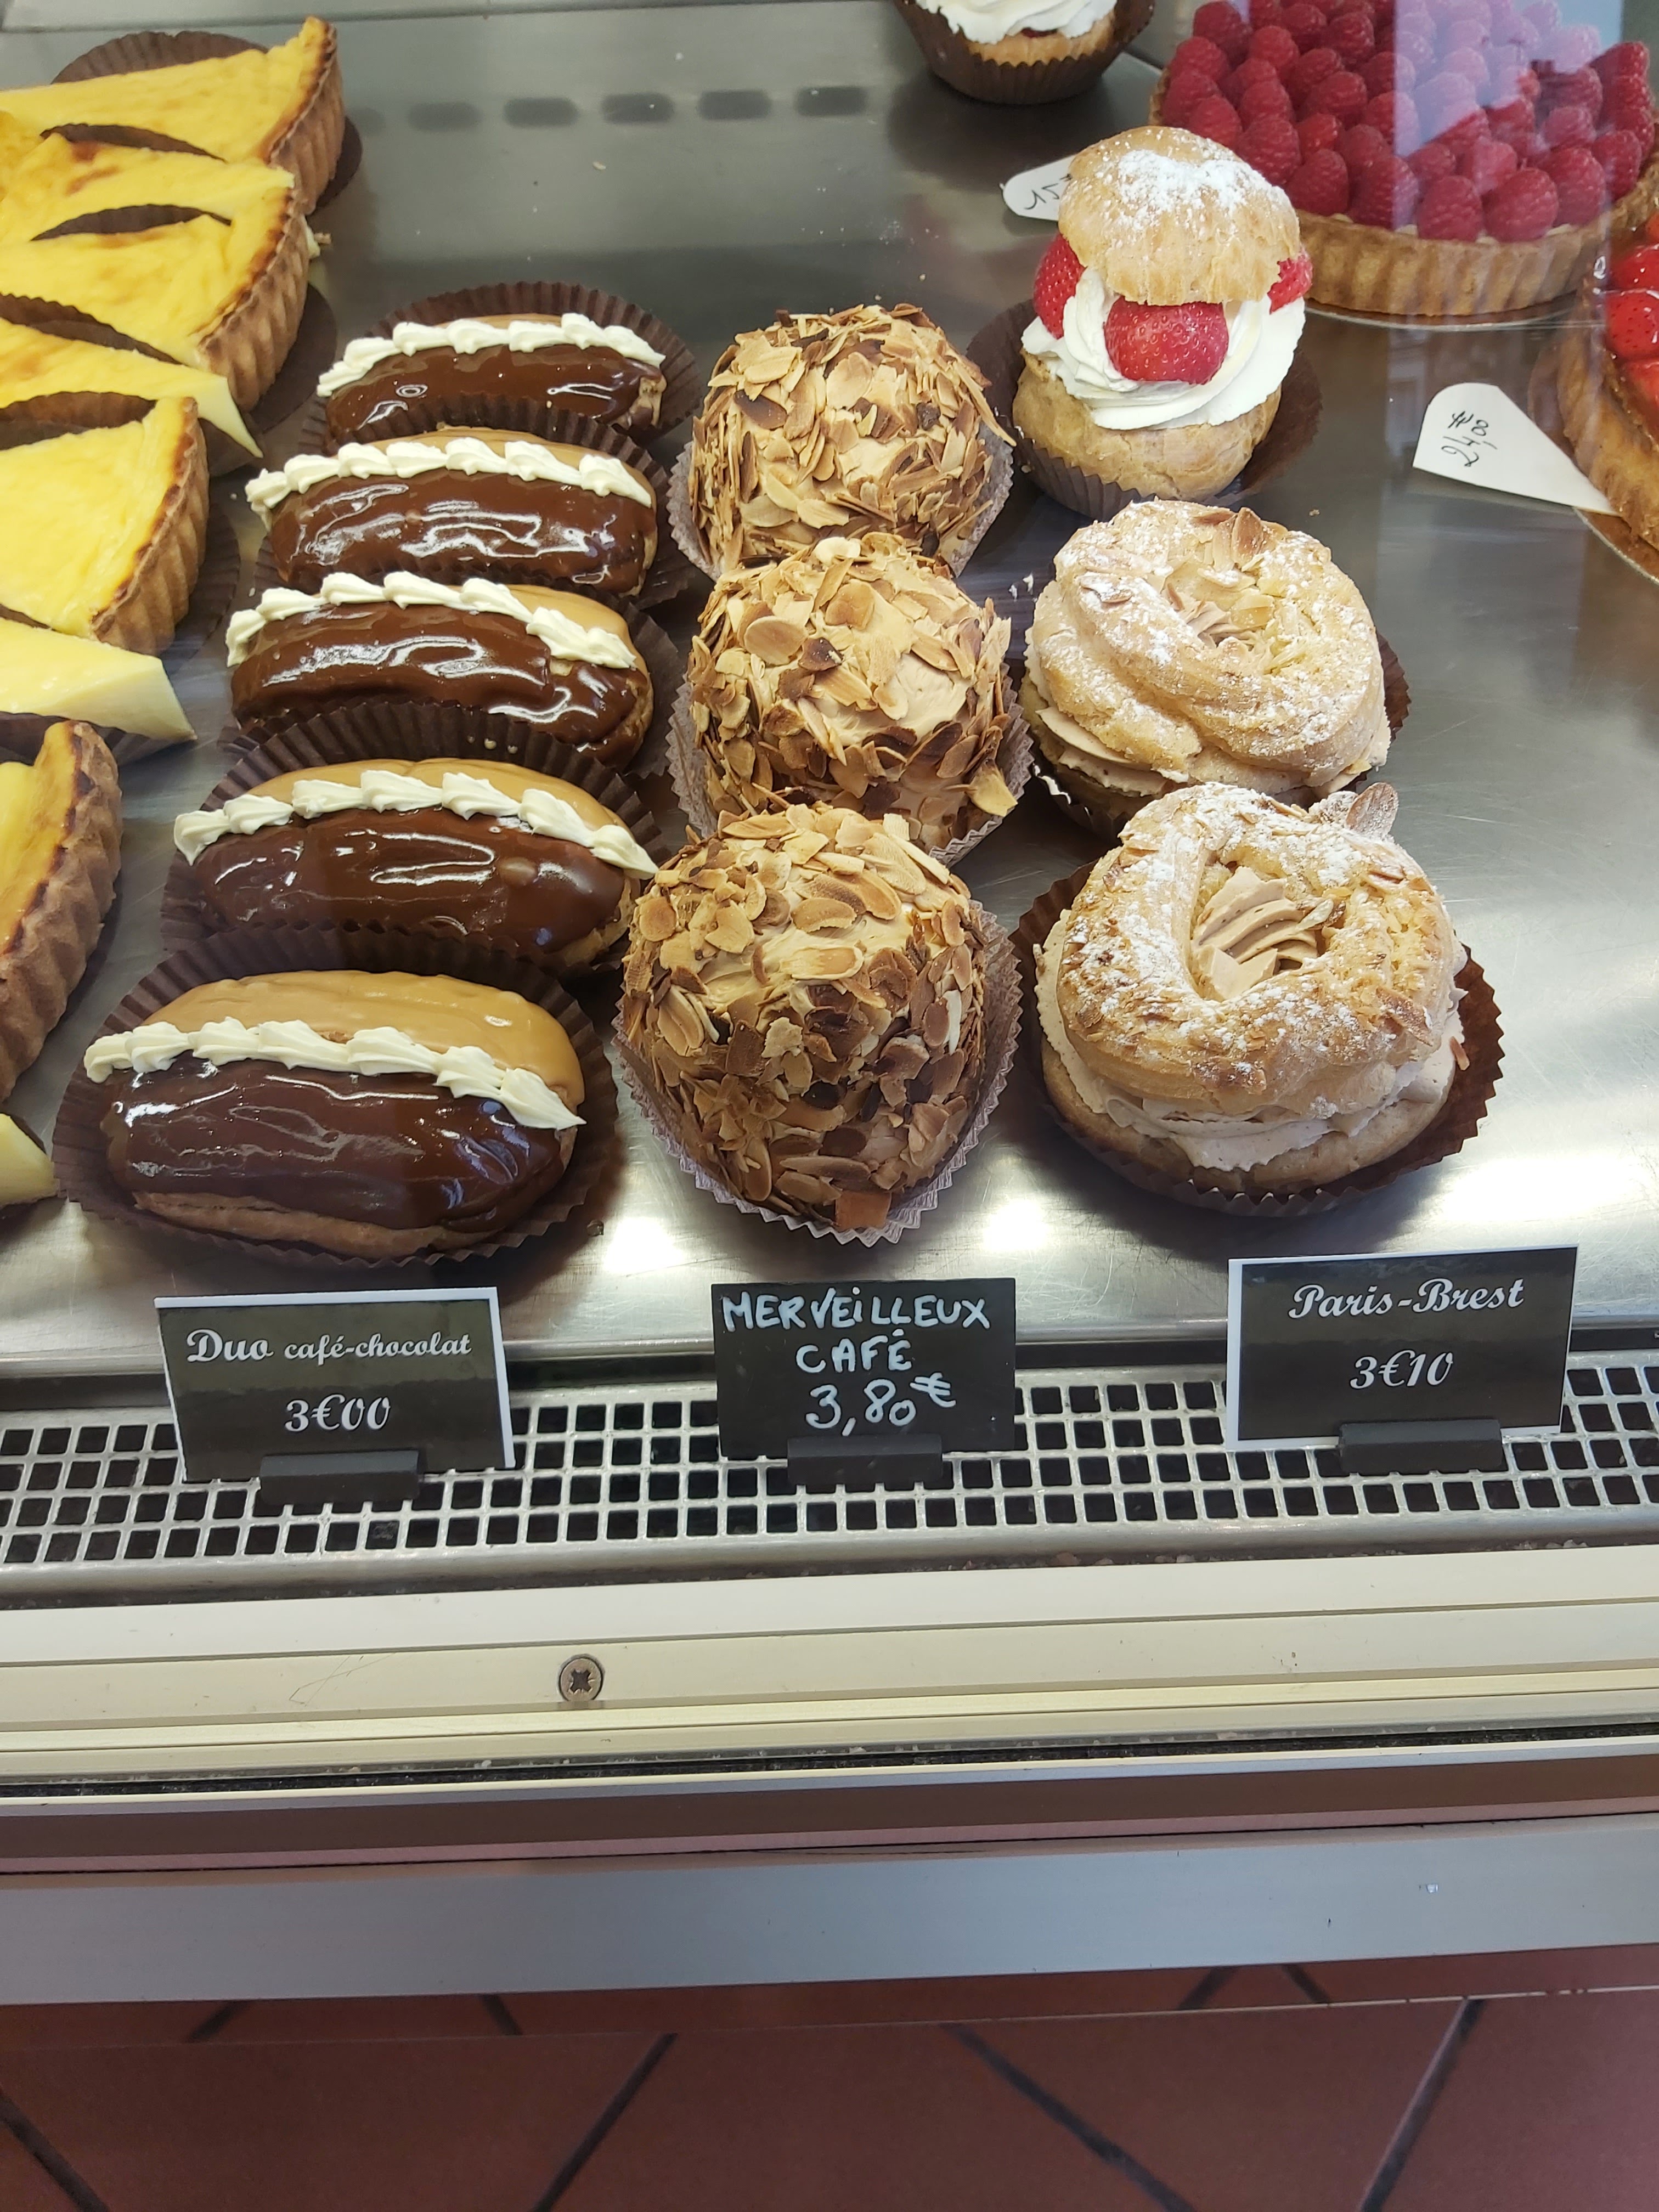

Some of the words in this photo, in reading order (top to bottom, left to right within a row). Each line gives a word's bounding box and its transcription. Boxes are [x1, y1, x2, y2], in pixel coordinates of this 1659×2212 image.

[1288, 1278, 1525, 1319] Paris-Brest
[186, 1328, 274, 1363] Duo
[284, 1331, 472, 1366] café-chocolat
[795, 1328, 912, 1374] CAFÉ
[1349, 1349, 1454, 1390] 3€10
[284, 1393, 391, 1432] 3€00
